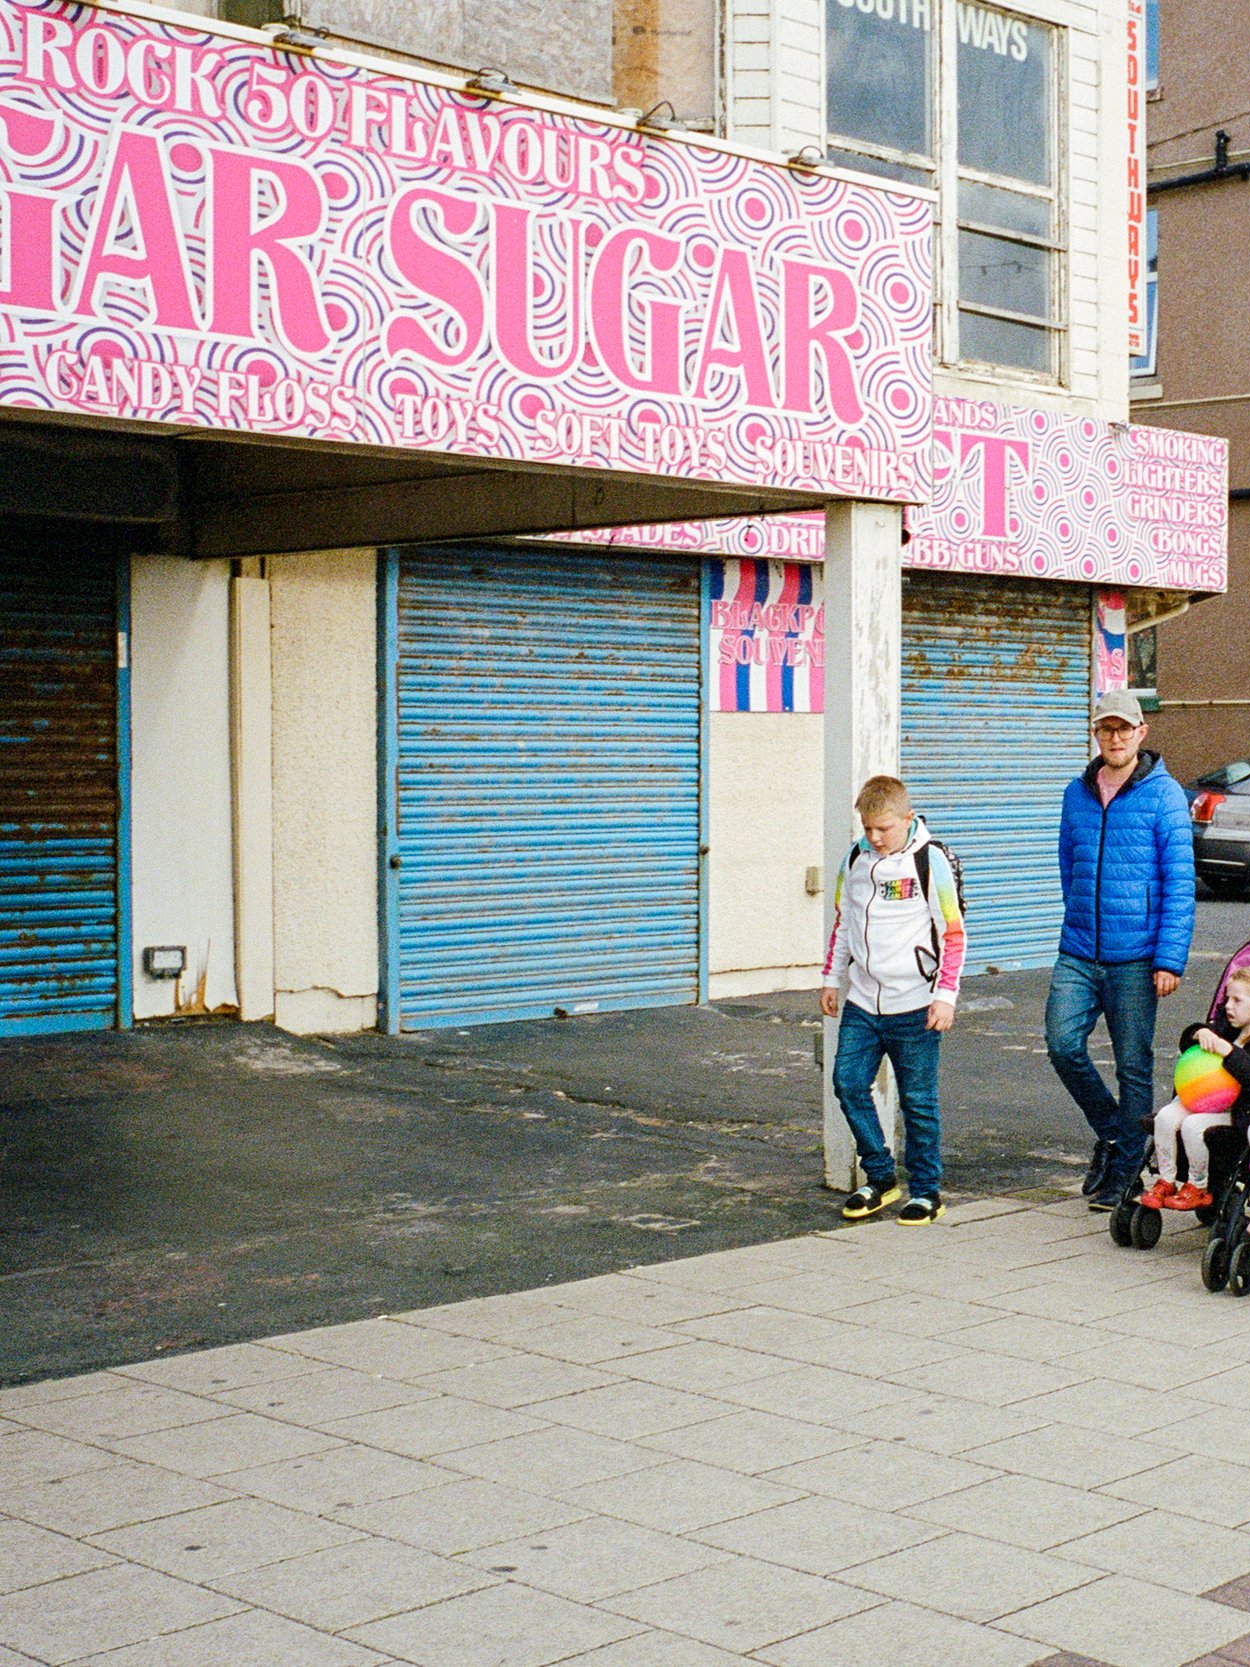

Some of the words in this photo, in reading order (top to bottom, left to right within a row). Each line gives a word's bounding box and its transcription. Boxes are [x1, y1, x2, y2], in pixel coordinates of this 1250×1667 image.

[958, 4, 1028, 62] WAYS
[24, 11, 226, 119] ROCK
[248, 62, 336, 139] 50
[349, 83, 646, 204] FLAVOURS
[1127, 20, 1142, 324] SOUTHWAYS
[385, 187, 867, 426] SUGAR
[46, 349, 203, 414] CANDY
[217, 368, 358, 431] FLOSS
[395, 394, 501, 447] TOYS
[535, 408, 627, 460] SOFT
[637, 419, 727, 469] TOYS
[753, 435, 916, 490] SOUVENIRS
[1135, 430, 1223, 465] SMOKING
[1123, 460, 1222, 496] LIGHTERS
[1126, 492, 1222, 527] GRINDERS
[914, 537, 950, 566] BB
[957, 541, 1020, 572] GUNS
[1157, 528, 1222, 558] BONGS
[1168, 560, 1223, 588] MUGS
